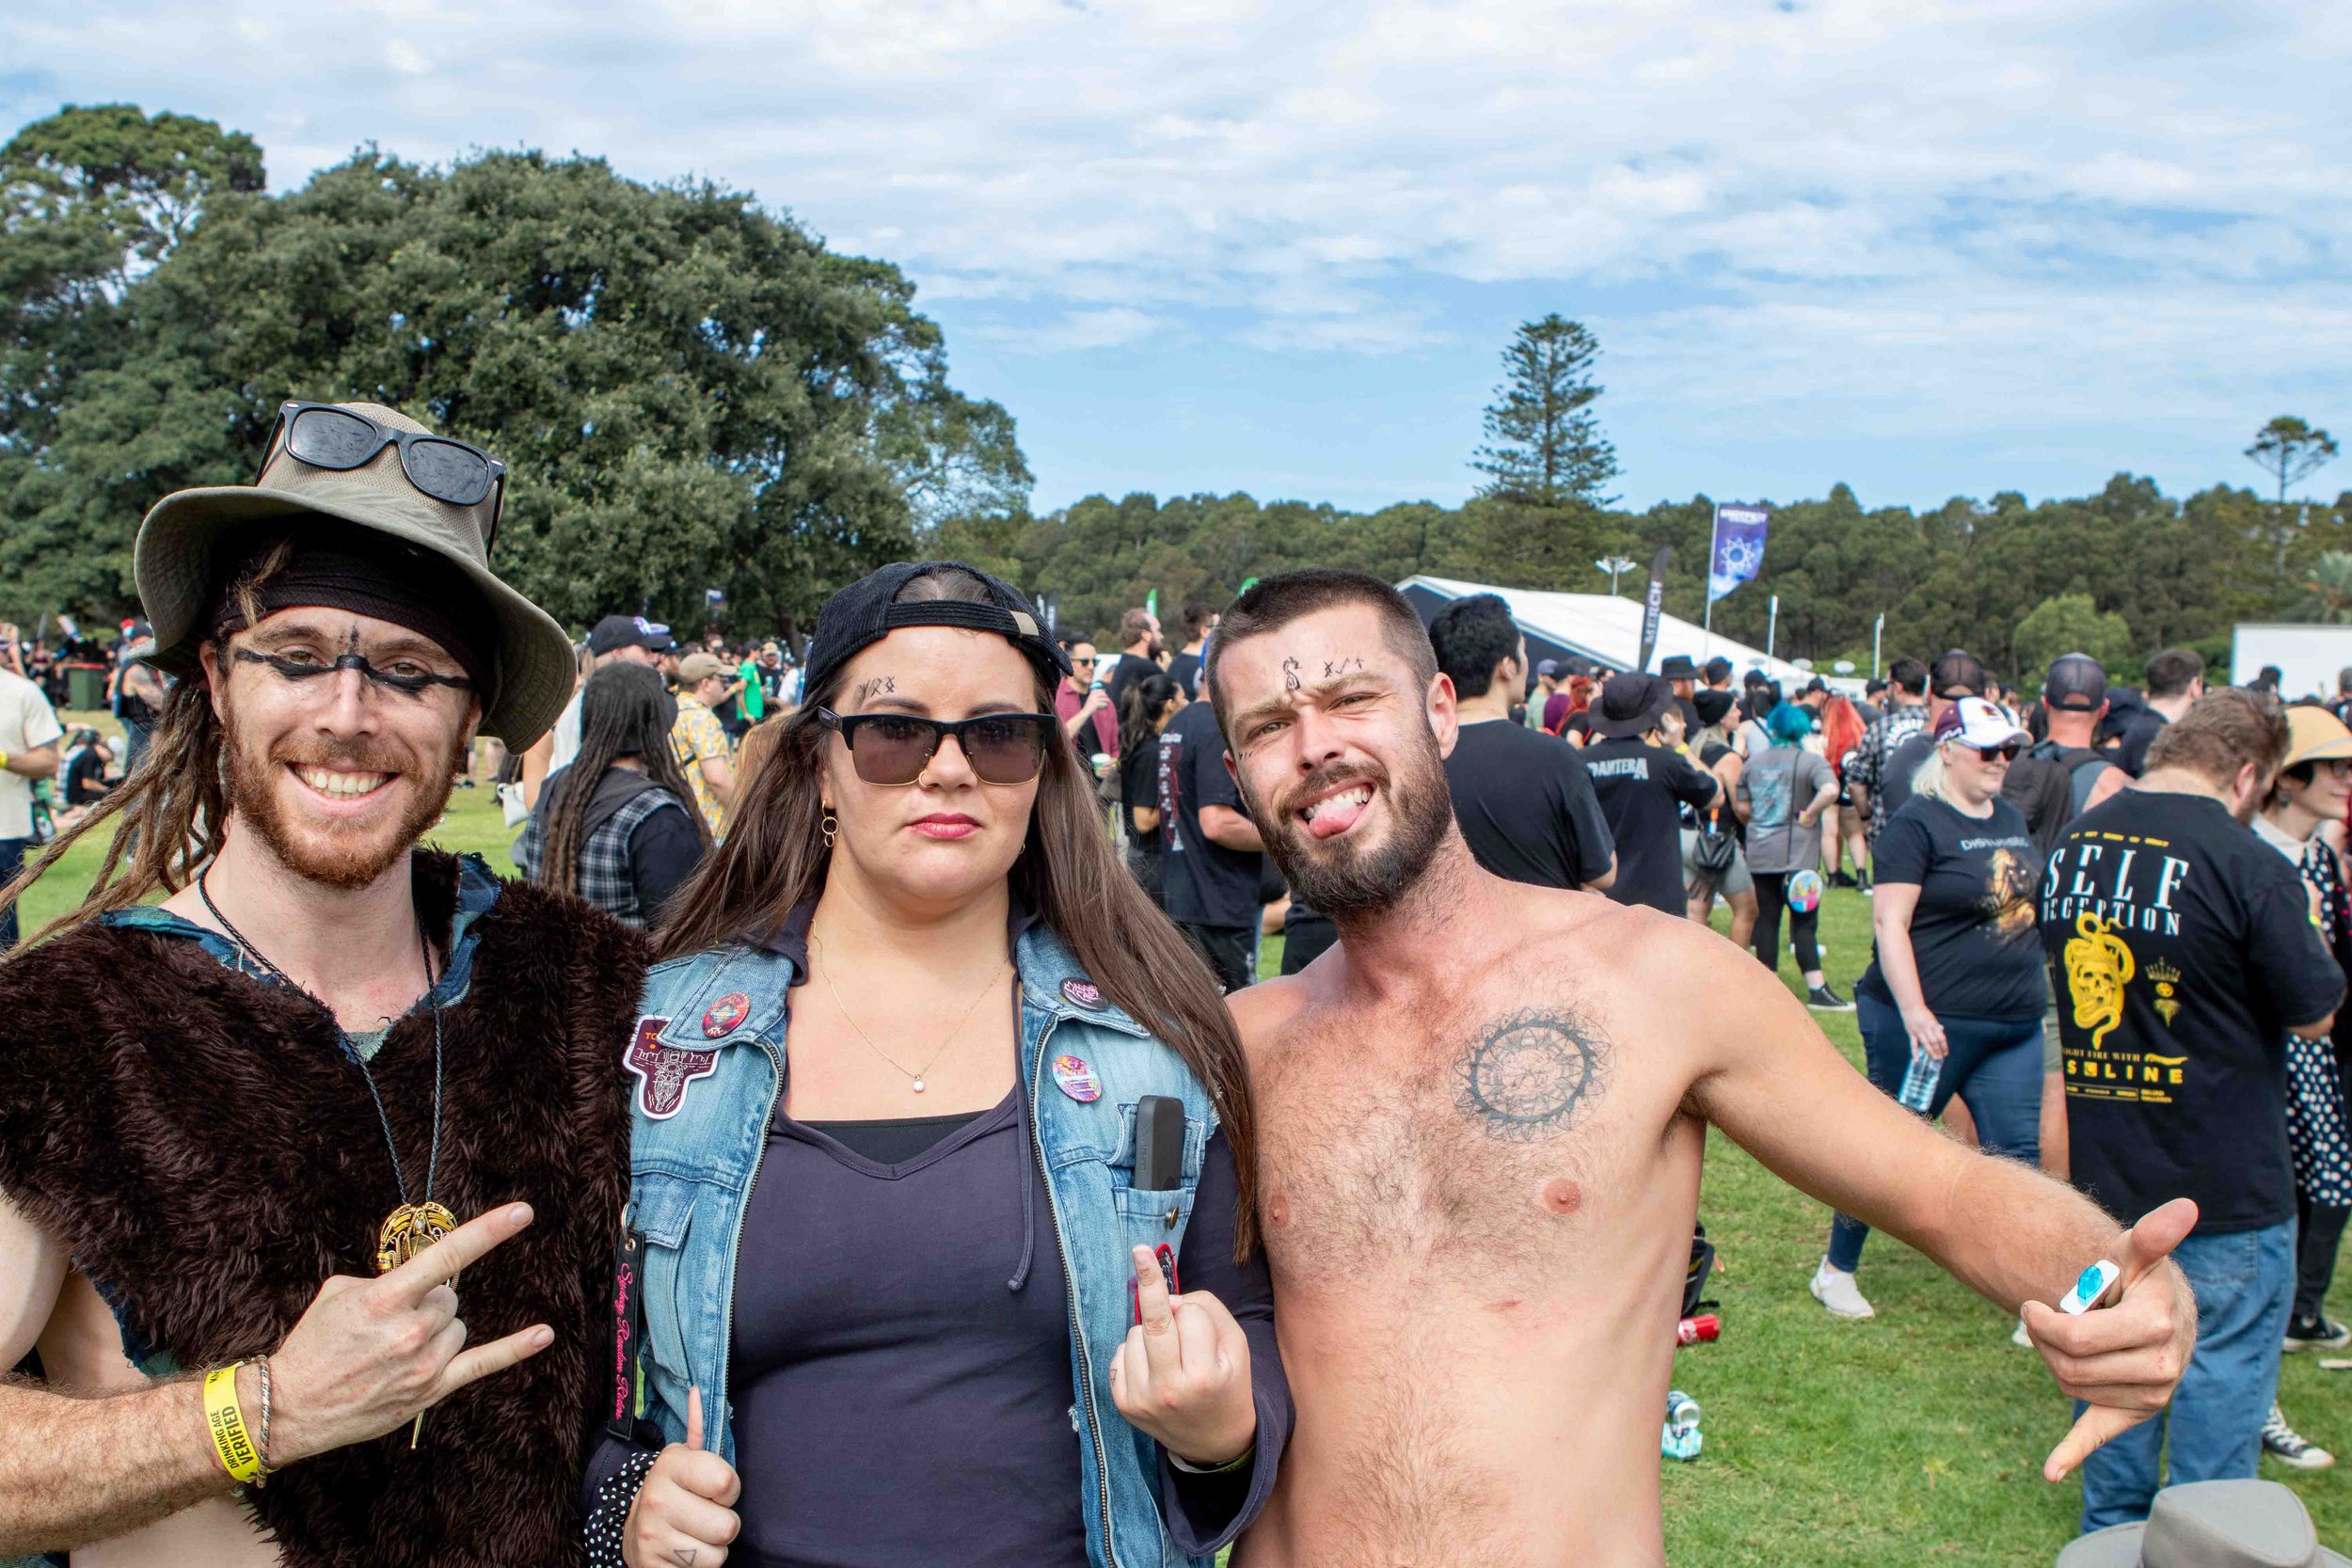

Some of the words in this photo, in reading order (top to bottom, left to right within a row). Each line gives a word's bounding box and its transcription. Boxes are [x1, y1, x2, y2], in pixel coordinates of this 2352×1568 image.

[1644, 581, 1662, 643] MERCH
[1587, 757, 1648, 780] PANTERA
[2043, 844, 2189, 910] SELF
[210, 1410, 223, 1428] AGE
[222, 1406, 254, 1465] VERIFIED
[215, 1429, 240, 1469] DRINKING
